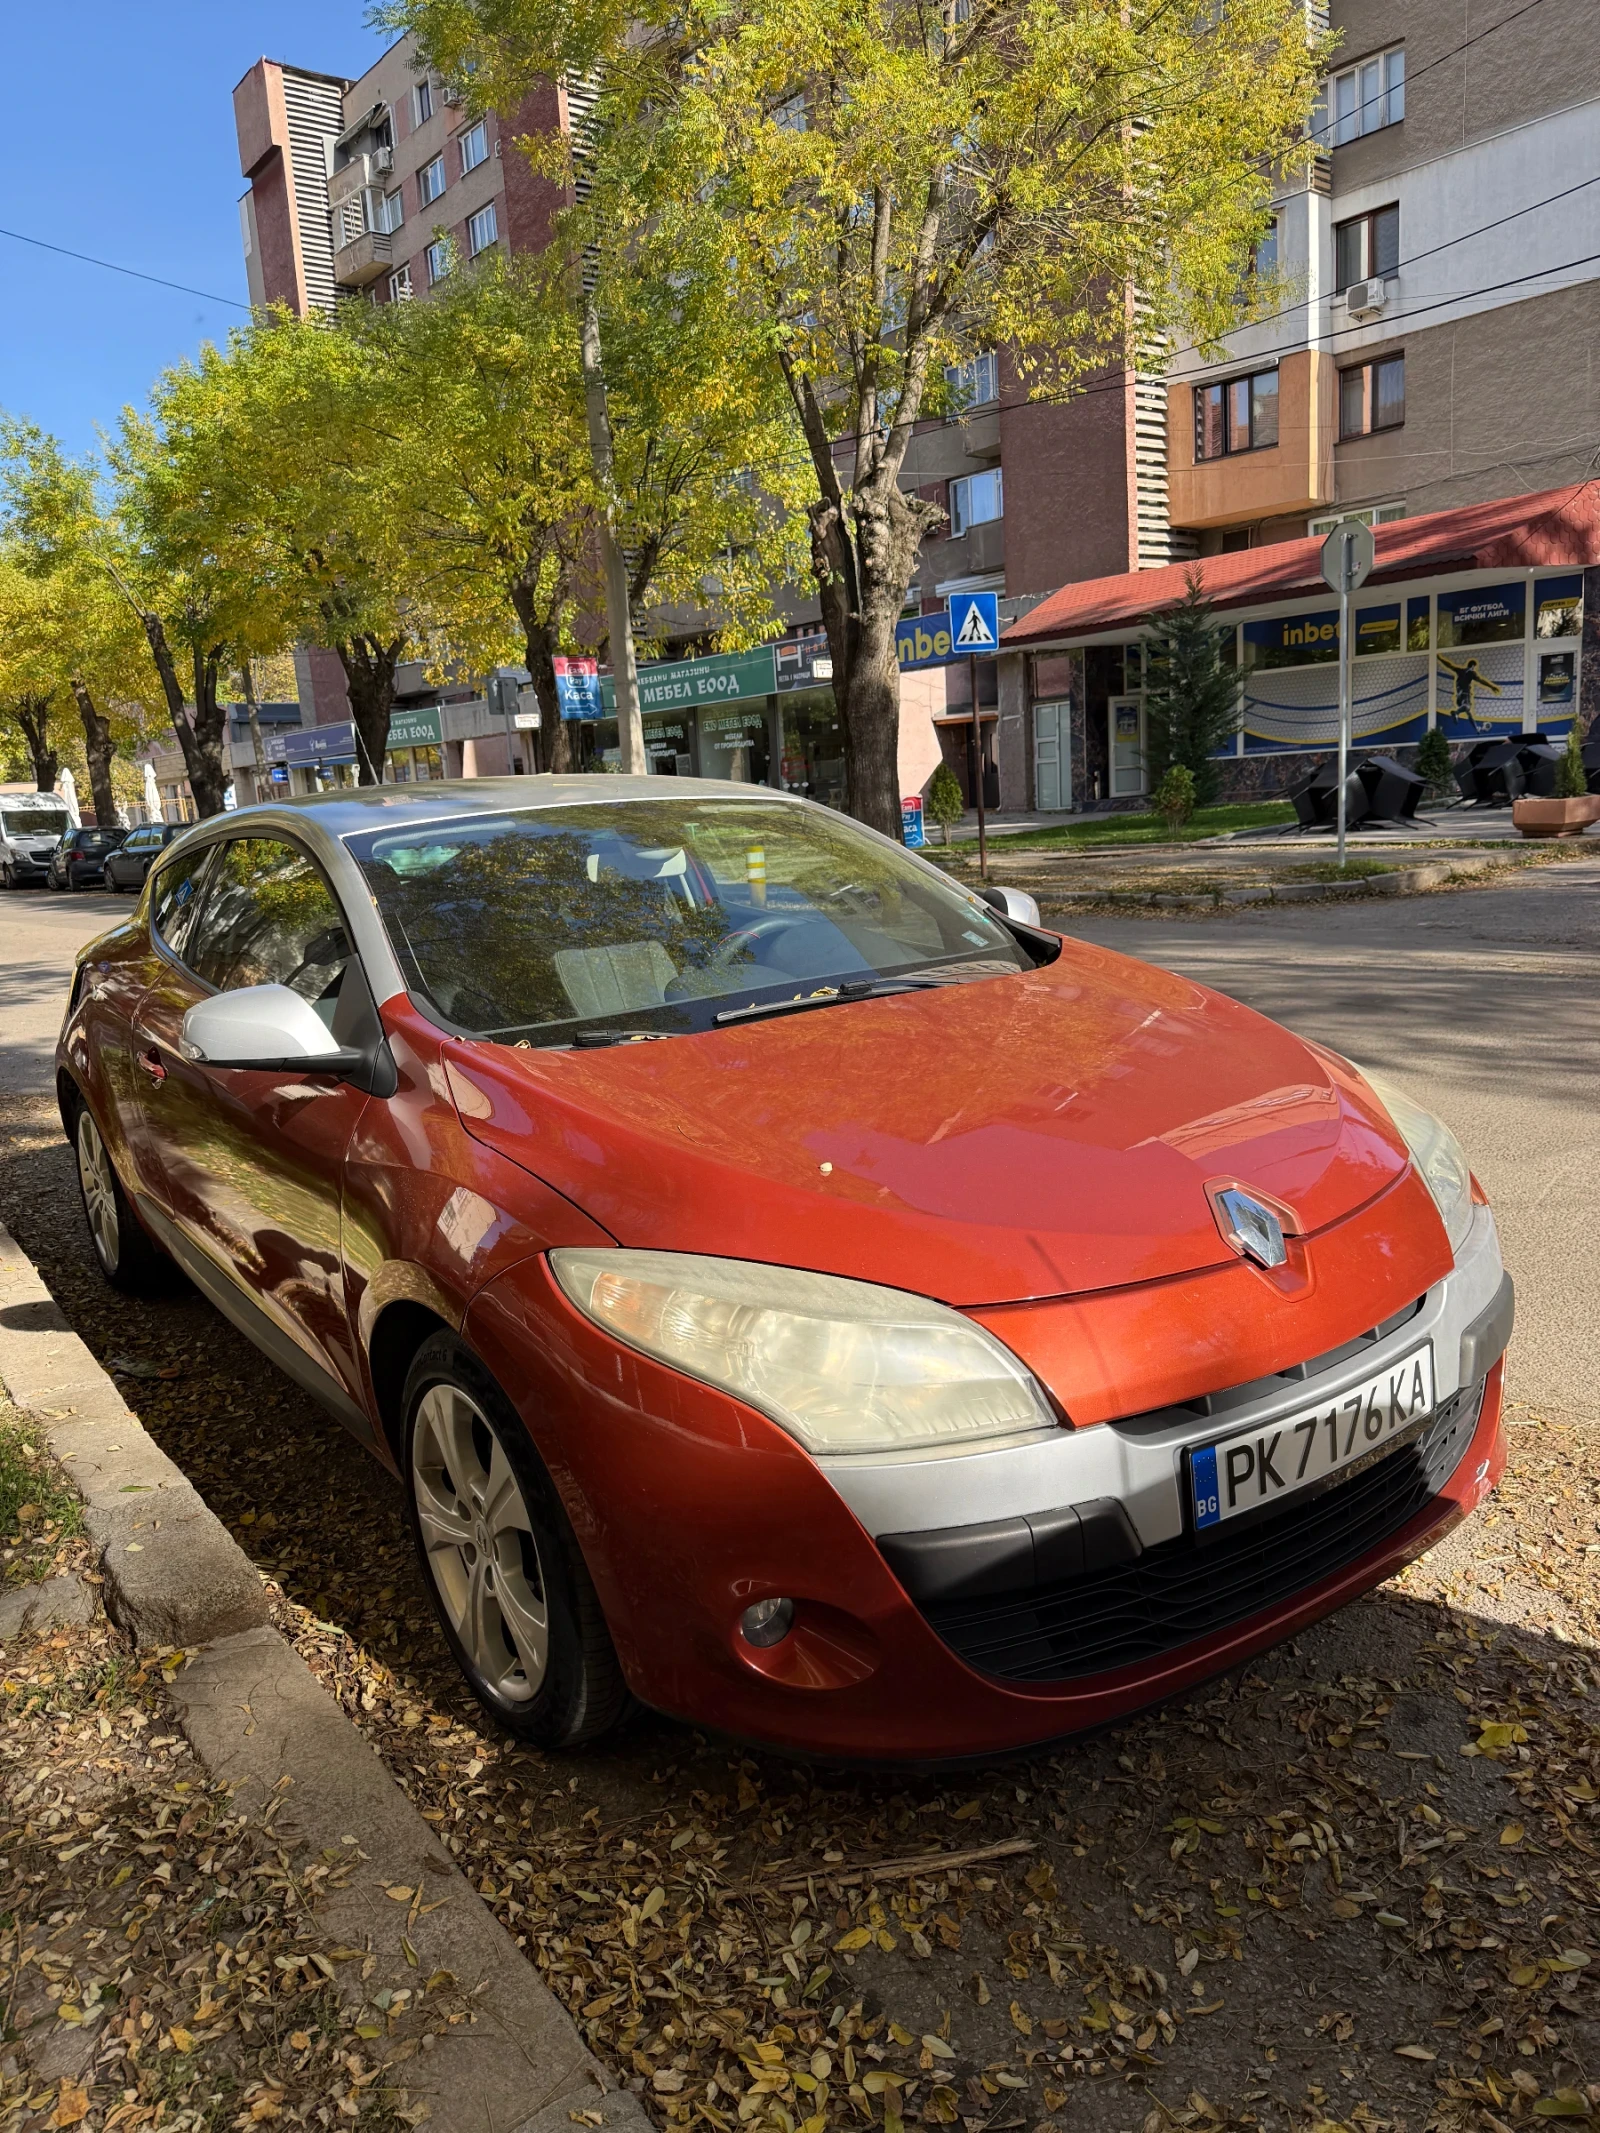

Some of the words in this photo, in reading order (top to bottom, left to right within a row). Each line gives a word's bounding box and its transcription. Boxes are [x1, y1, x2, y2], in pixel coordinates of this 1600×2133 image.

[1459, 606, 1469, 614] БГ
[1470, 602, 1504, 613] ФУТБОЛ
[1454, 612, 1486, 623] ВСИЧКИ
[1487, 609, 1510, 619] ЛИГИ
[897, 627, 951, 663] nbe
[568, 666, 586, 675] Easy
[670, 666, 710, 680] МАГАЗИНИ
[569, 676, 583, 687] Pay
[643, 682, 693, 703] МЕБЕЛ
[696, 674, 740, 695] ЕООД
[564, 689, 594, 701] Каса
[387, 728, 408, 741] ЕБЕЛ
[410, 725, 435, 739] ЕООД
[903, 824, 919, 834] аса
[1196, 1495, 1217, 1518] BG
